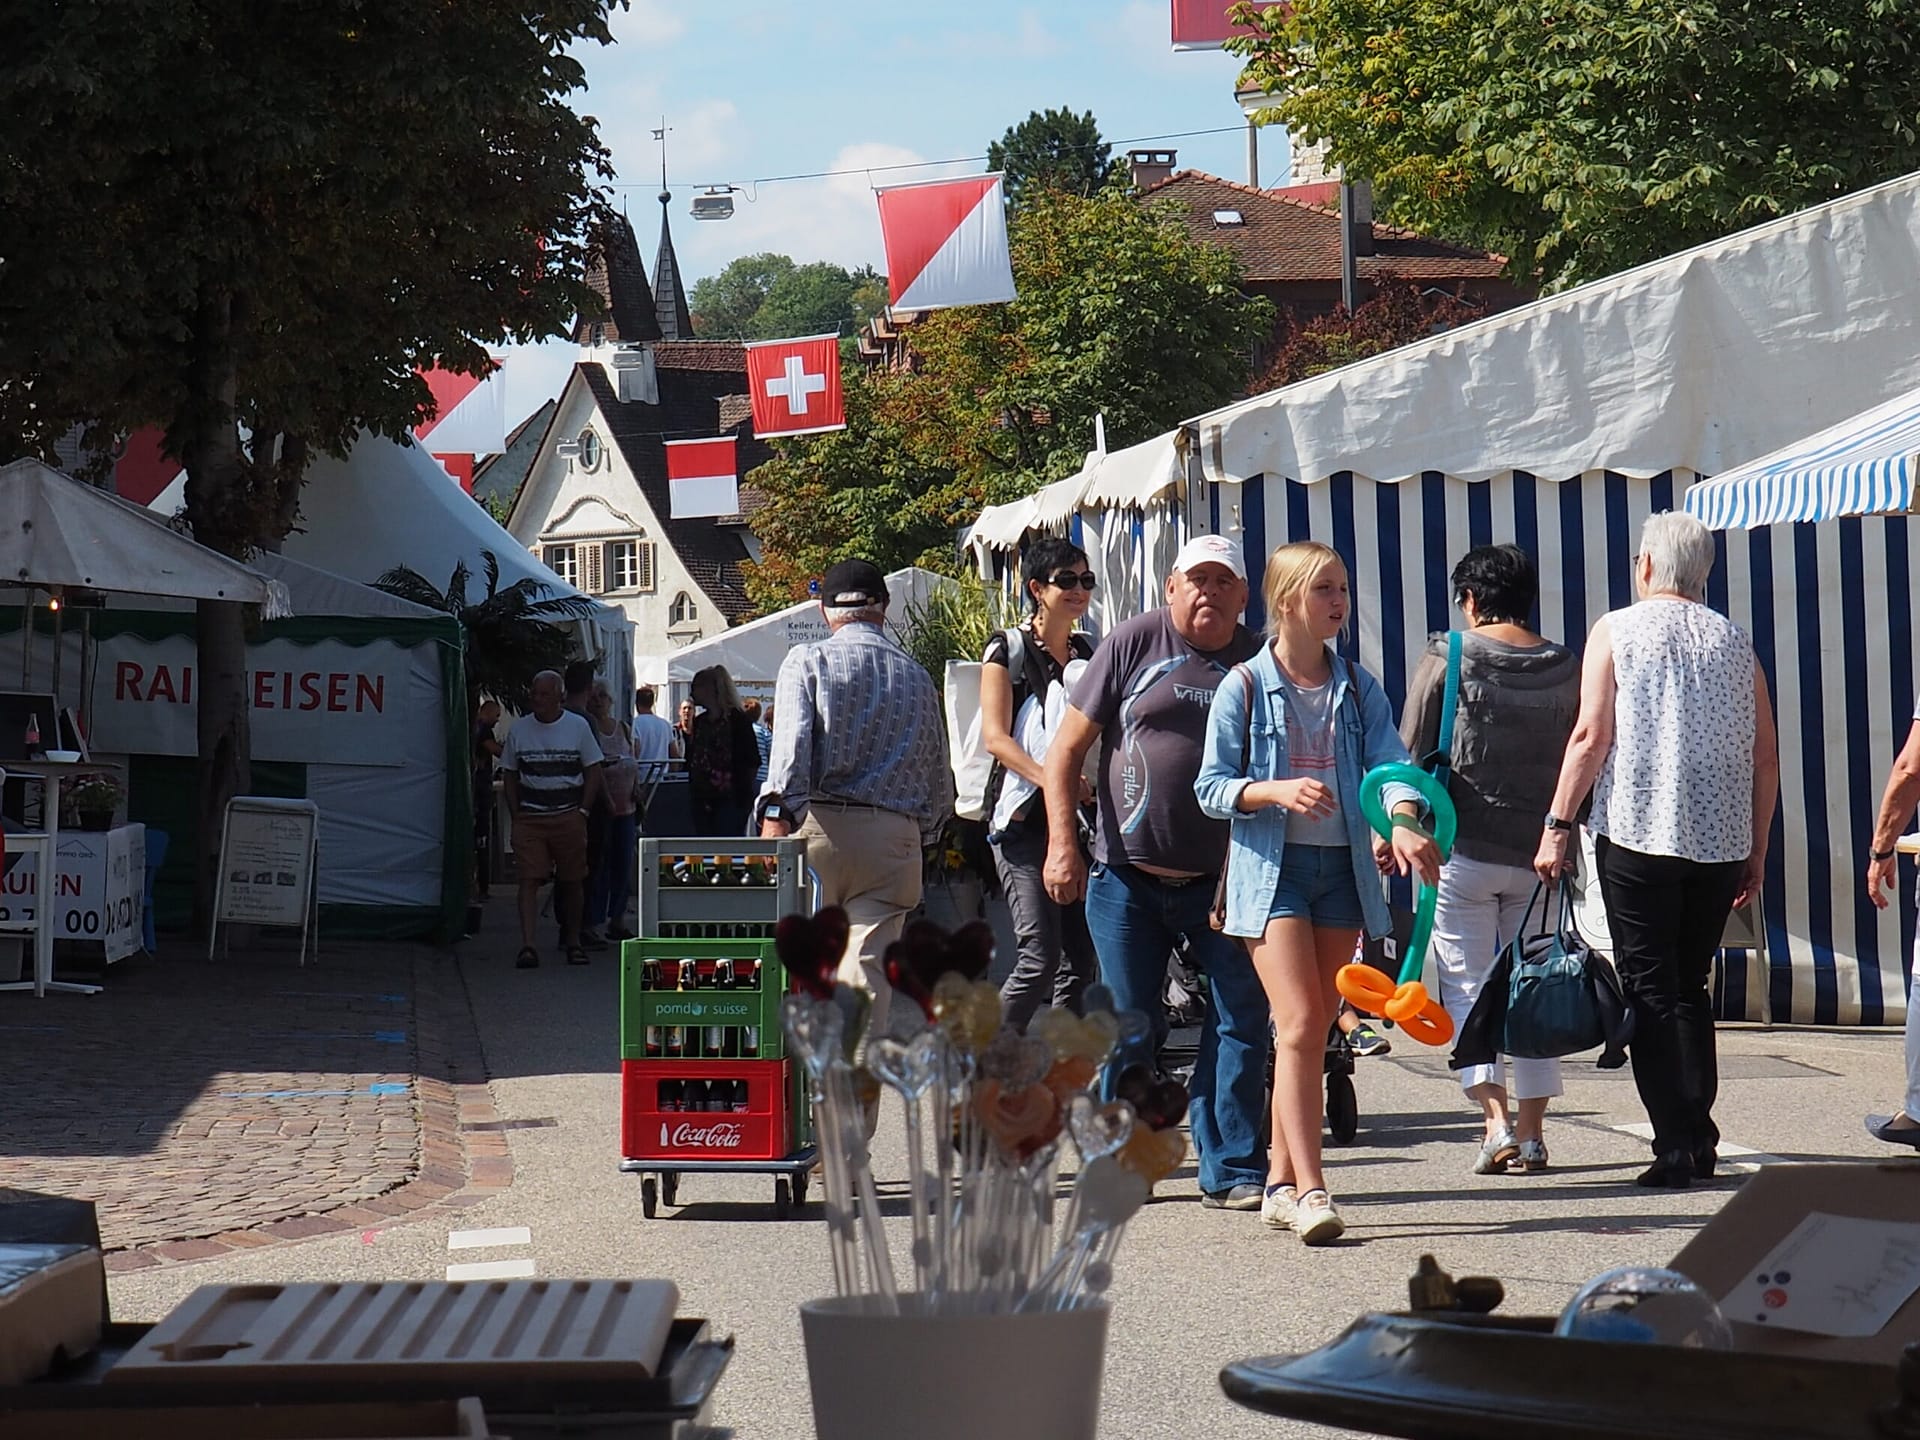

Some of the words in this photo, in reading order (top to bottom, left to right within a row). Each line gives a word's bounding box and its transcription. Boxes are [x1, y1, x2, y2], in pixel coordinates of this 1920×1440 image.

[788, 632, 809, 641] 5705
[116, 660, 384, 714] RAIEISEN
[65, 909, 99, 934] 00
[713, 1003, 748, 1015] suisse
[672, 1122, 744, 1147] Coca-Cola
